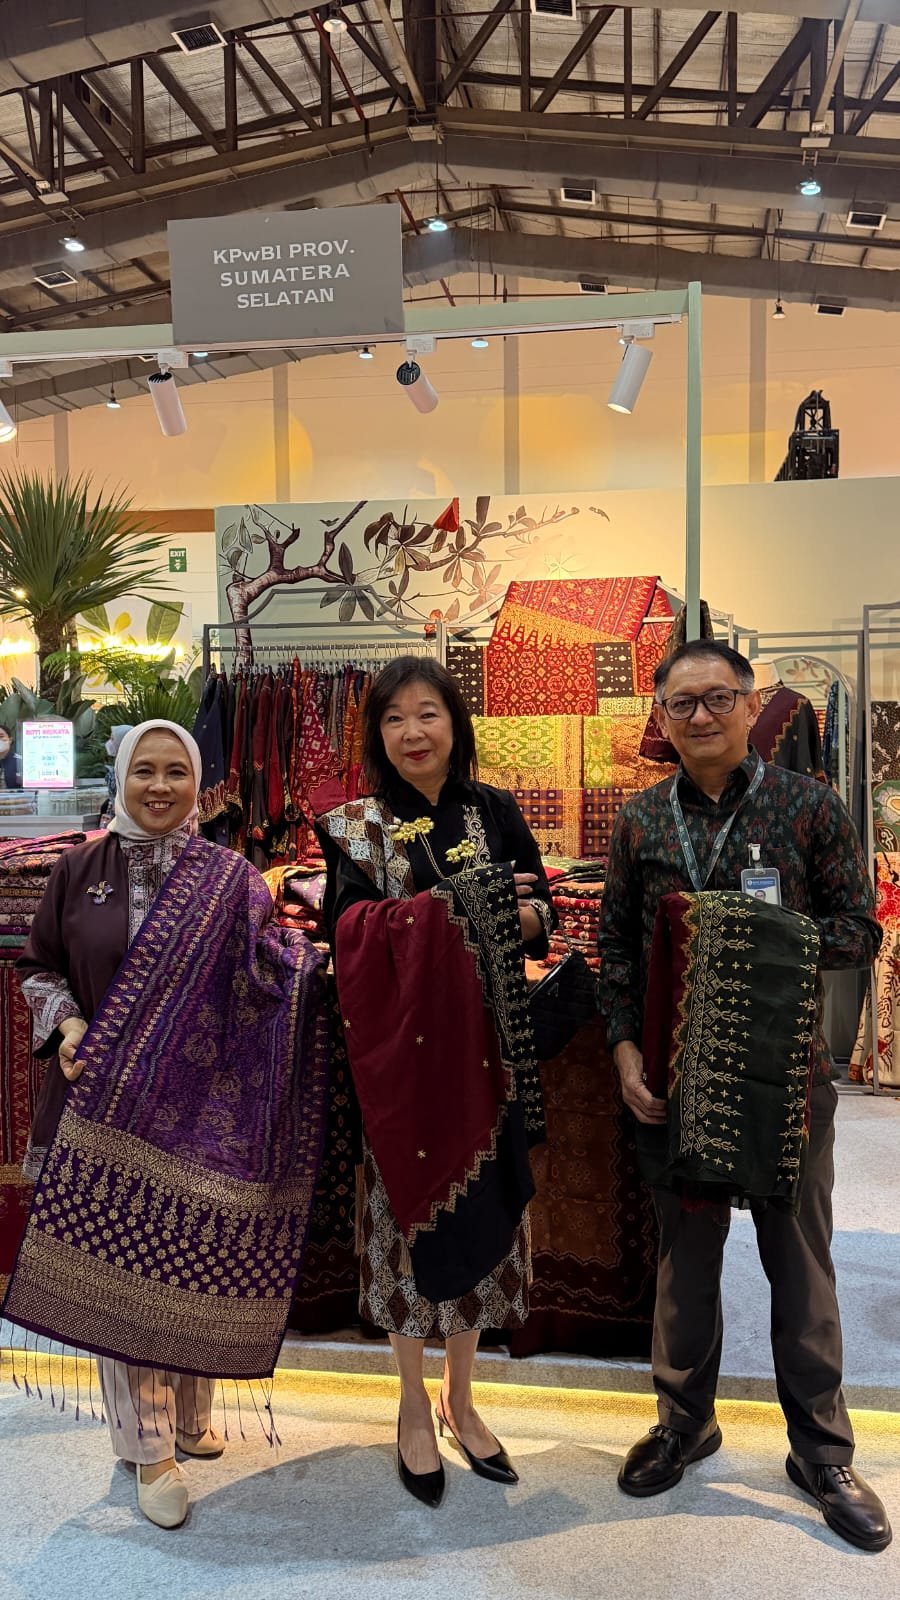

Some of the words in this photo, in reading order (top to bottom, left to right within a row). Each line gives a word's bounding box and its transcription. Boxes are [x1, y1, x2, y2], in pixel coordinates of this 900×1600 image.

[213, 245, 281, 264] KPwBI
[289, 239, 356, 258] PROV.
[220, 263, 350, 287] SUMATERA
[237, 287, 334, 309] SELATAN
